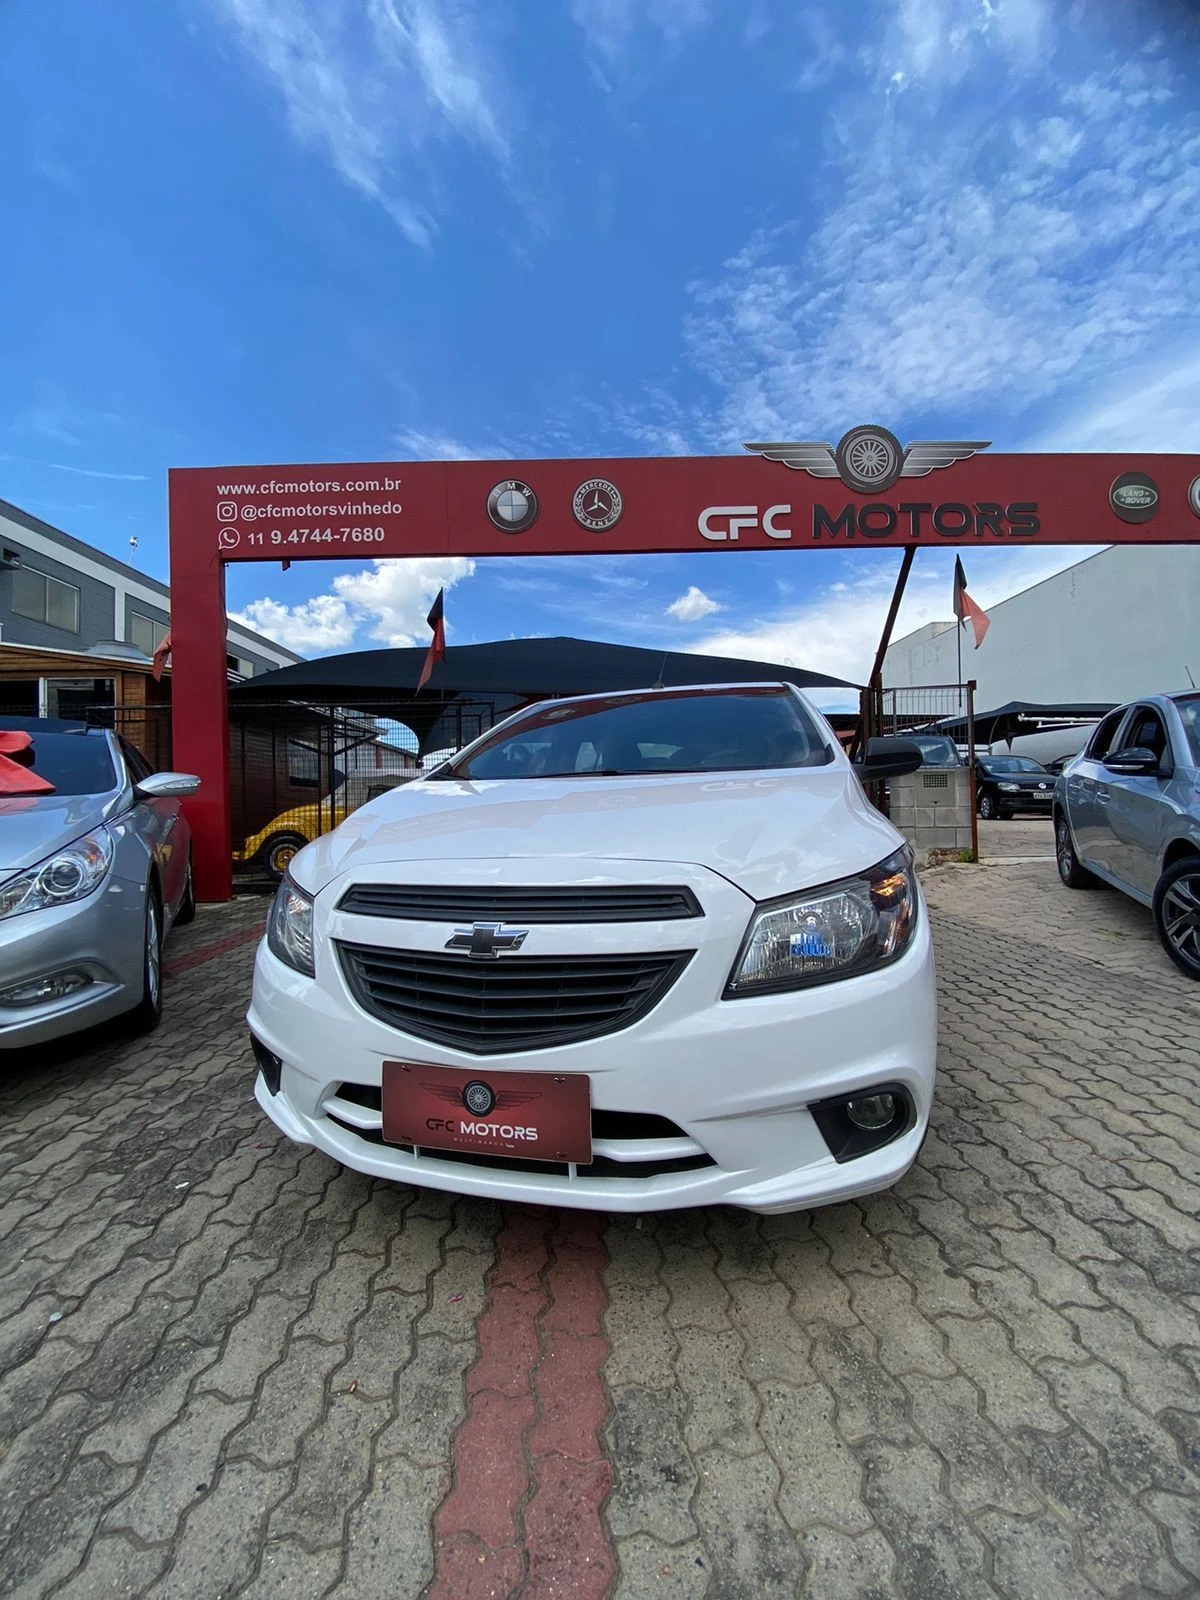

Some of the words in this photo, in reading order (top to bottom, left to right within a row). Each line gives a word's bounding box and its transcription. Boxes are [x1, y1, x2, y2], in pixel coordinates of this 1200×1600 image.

[217, 478, 402, 496] www.cfcmotors.com.br
[240, 501, 403, 522] @cfcmotorsvinhedo
[697, 504, 792, 541] CFC
[811, 502, 1041, 539] MOTORS
[247, 532, 264, 545] 11
[270, 527, 386, 545] 9.4744-7680
[426, 1118, 454, 1132] CFC
[460, 1121, 538, 1141] MOTORS
